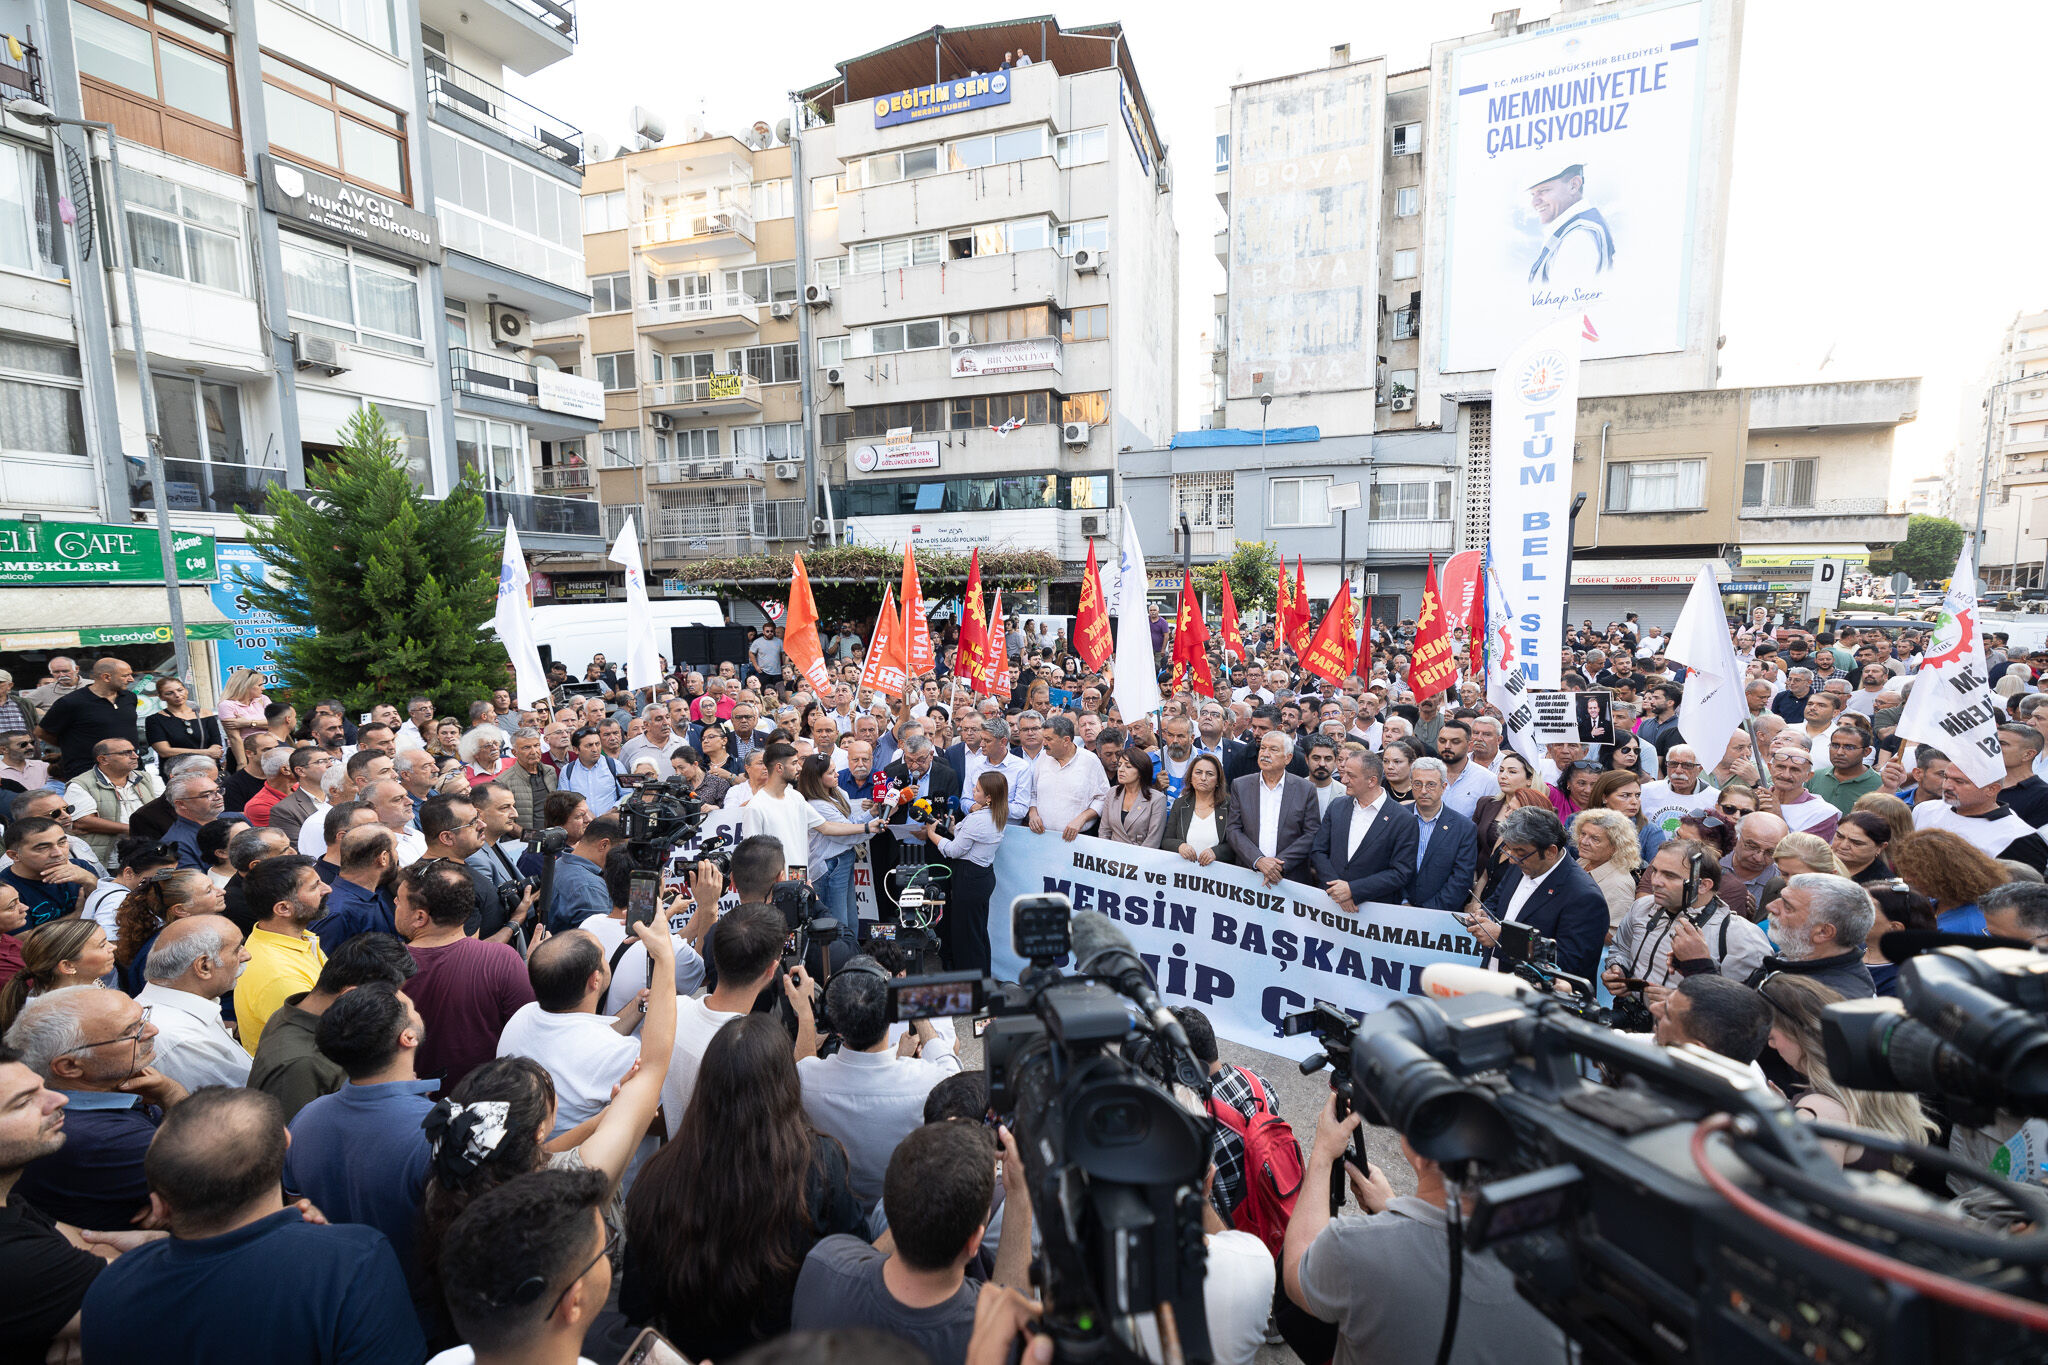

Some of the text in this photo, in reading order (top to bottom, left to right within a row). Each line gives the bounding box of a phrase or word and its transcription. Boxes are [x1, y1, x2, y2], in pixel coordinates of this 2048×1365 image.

[1494, 45, 1664, 88] T.C. MERSİN BÜYÜKŞEHİR BELEDİYESİ
[890, 77, 990, 113] EĞİTİM SEN
[1488, 61, 1669, 124] MEMNUNİYETLE
[911, 99, 971, 118] MERSİN ŞUBESİ
[1486, 102, 1630, 159] ÇALIŞIYORUZ
[1255, 154, 1353, 188] BOYA
[338, 187, 395, 219] AVCU
[306, 191, 431, 246] HUKUK BÜROSU
[342, 224, 369, 239] AVCU
[1252, 258, 1349, 288] BOYA
[1531, 290, 1569, 310] Vahap
[1273, 358, 1344, 383] OYA
[710, 377, 739, 390] SATILIK
[1519, 410, 1557, 486] TÜM
[54, 531, 137, 560] CAFE
[172, 535, 203, 553] zleme
[0, 560, 121, 572] MEKLERİ
[186, 556, 207, 572] Çay
[1821, 563, 1835, 582] D
[568, 582, 602, 590] MEHMET
[1614, 576, 1643, 584] SABOŞ
[100, 630, 157, 645] trendyol
[234, 637, 267, 649] 100
[1072, 851, 1139, 881] HAKSIZ
[1144, 870, 1167, 886] ve
[1173, 872, 1286, 914] HUKUKSUZ
[1043, 876, 1197, 935] MERSİN
